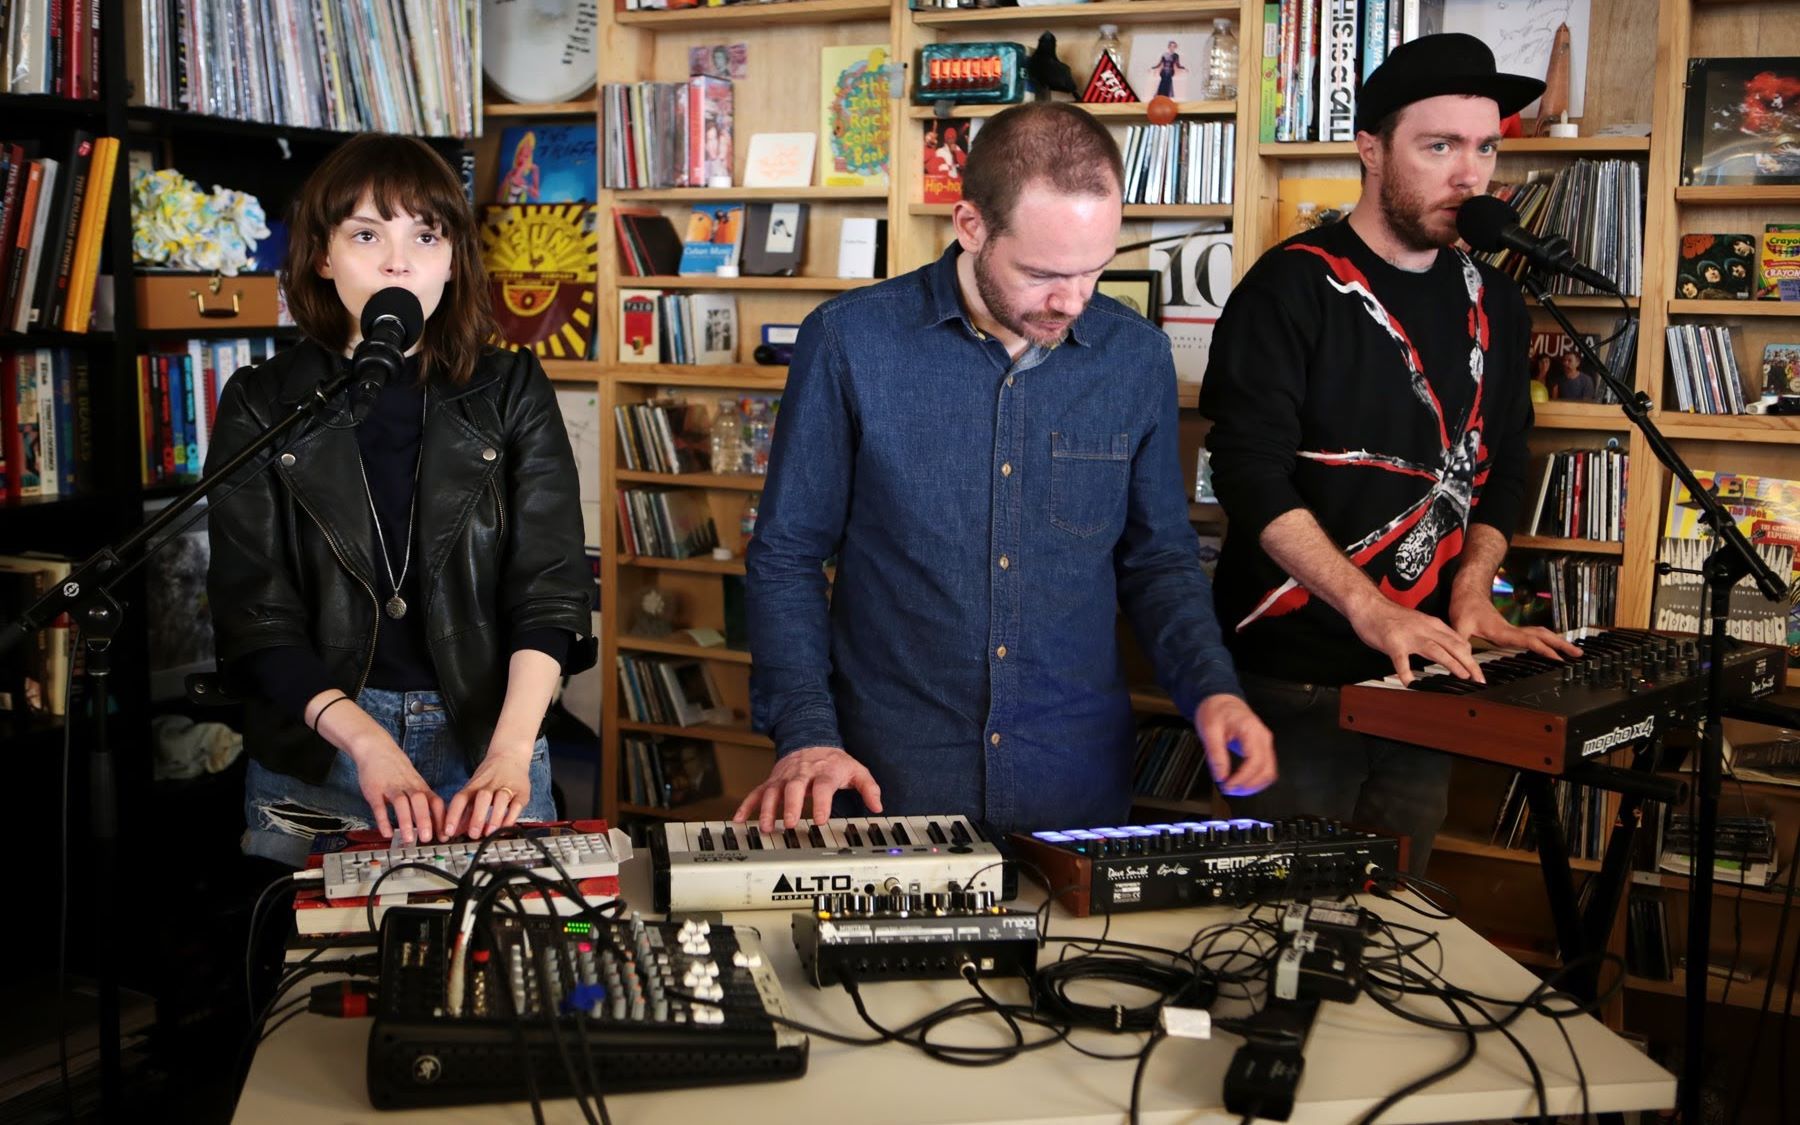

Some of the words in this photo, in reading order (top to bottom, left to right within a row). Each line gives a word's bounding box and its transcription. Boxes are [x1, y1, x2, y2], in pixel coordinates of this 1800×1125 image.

[1374, 22, 1385, 44] BOY
[1329, 86, 1353, 141] CALL
[74, 175, 85, 194] THE
[66, 195, 81, 238] ROLLING
[60, 239, 75, 277] STONES
[1155, 242, 1233, 309] 10
[1581, 726, 1633, 757] mopho
[1632, 714, 1656, 739] x4
[772, 873, 852, 894] ALTO
[1126, 865, 1149, 878] Smith
